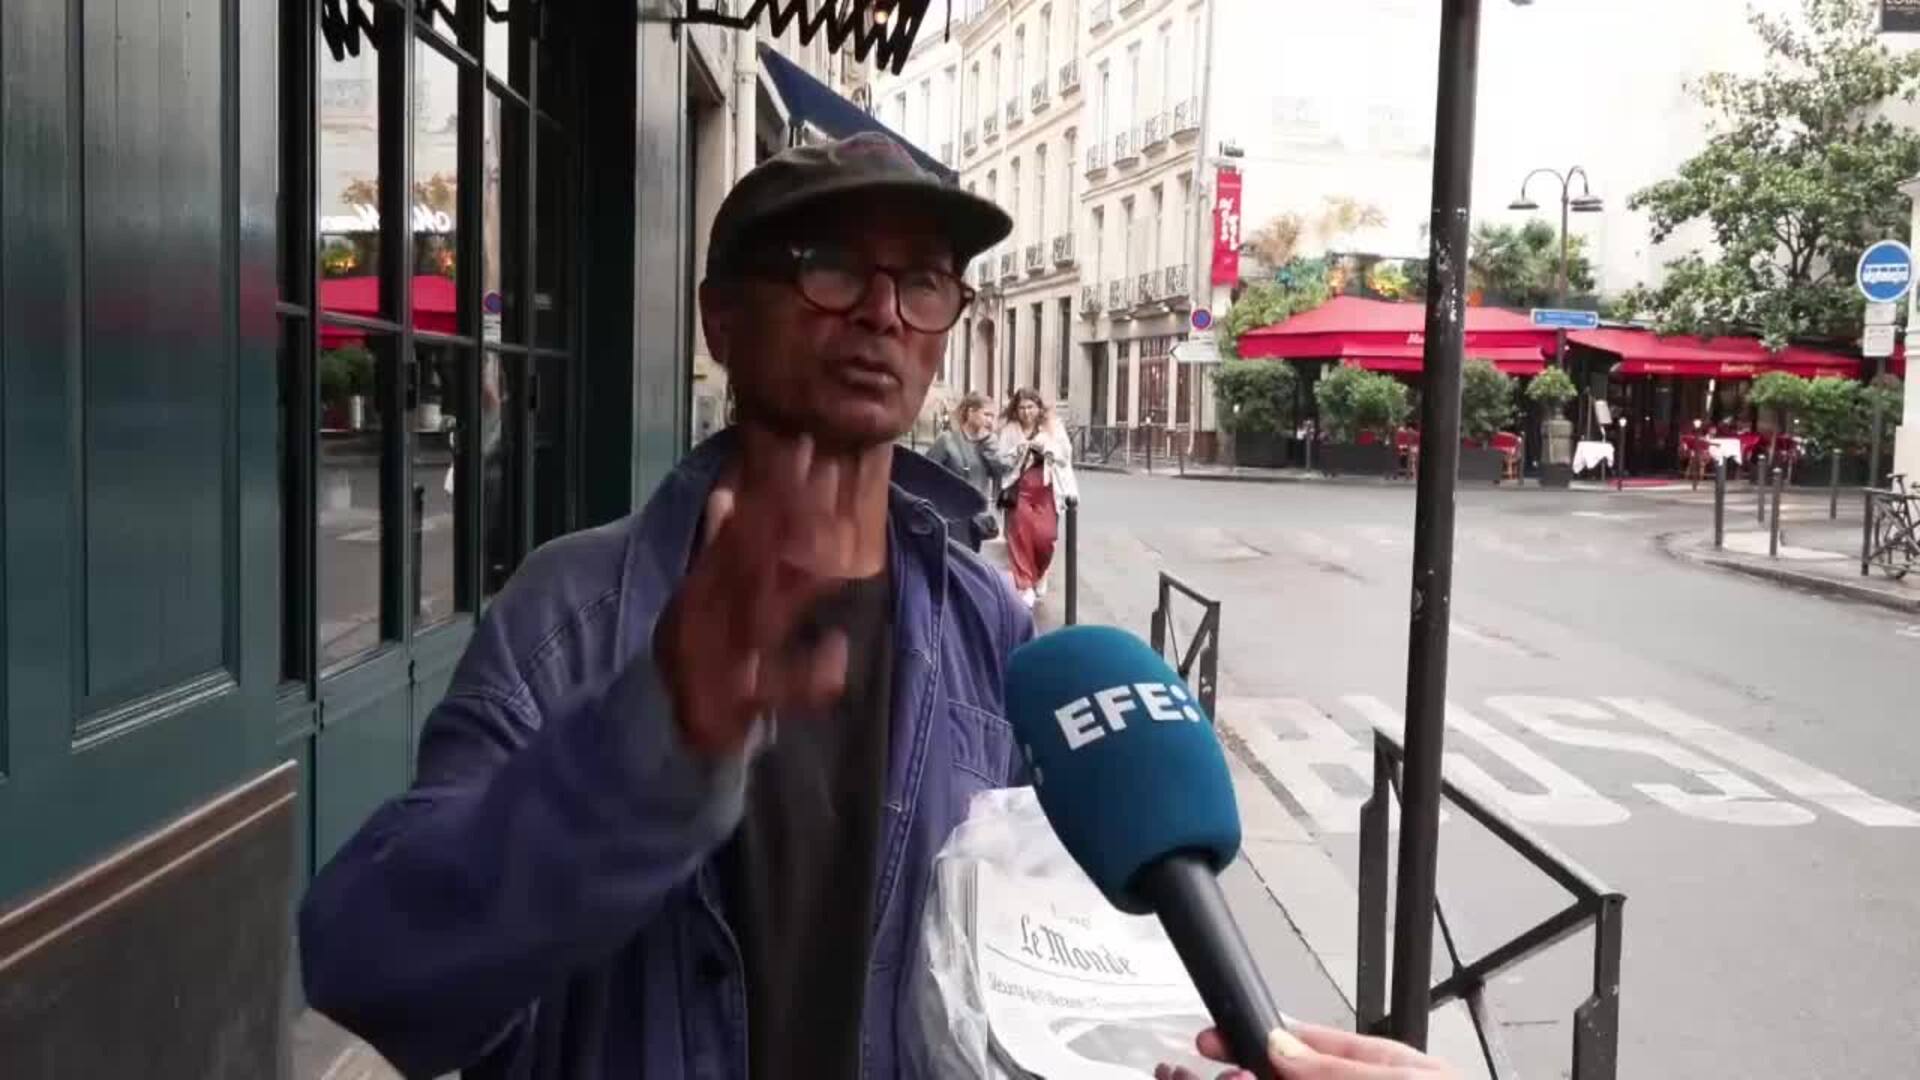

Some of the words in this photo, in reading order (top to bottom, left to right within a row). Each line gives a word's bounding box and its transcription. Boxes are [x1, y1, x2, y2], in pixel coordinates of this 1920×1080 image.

[1212, 695, 1817, 832] BUS
[1020, 914, 1043, 959] Le
[1039, 924, 1138, 976] Monde
